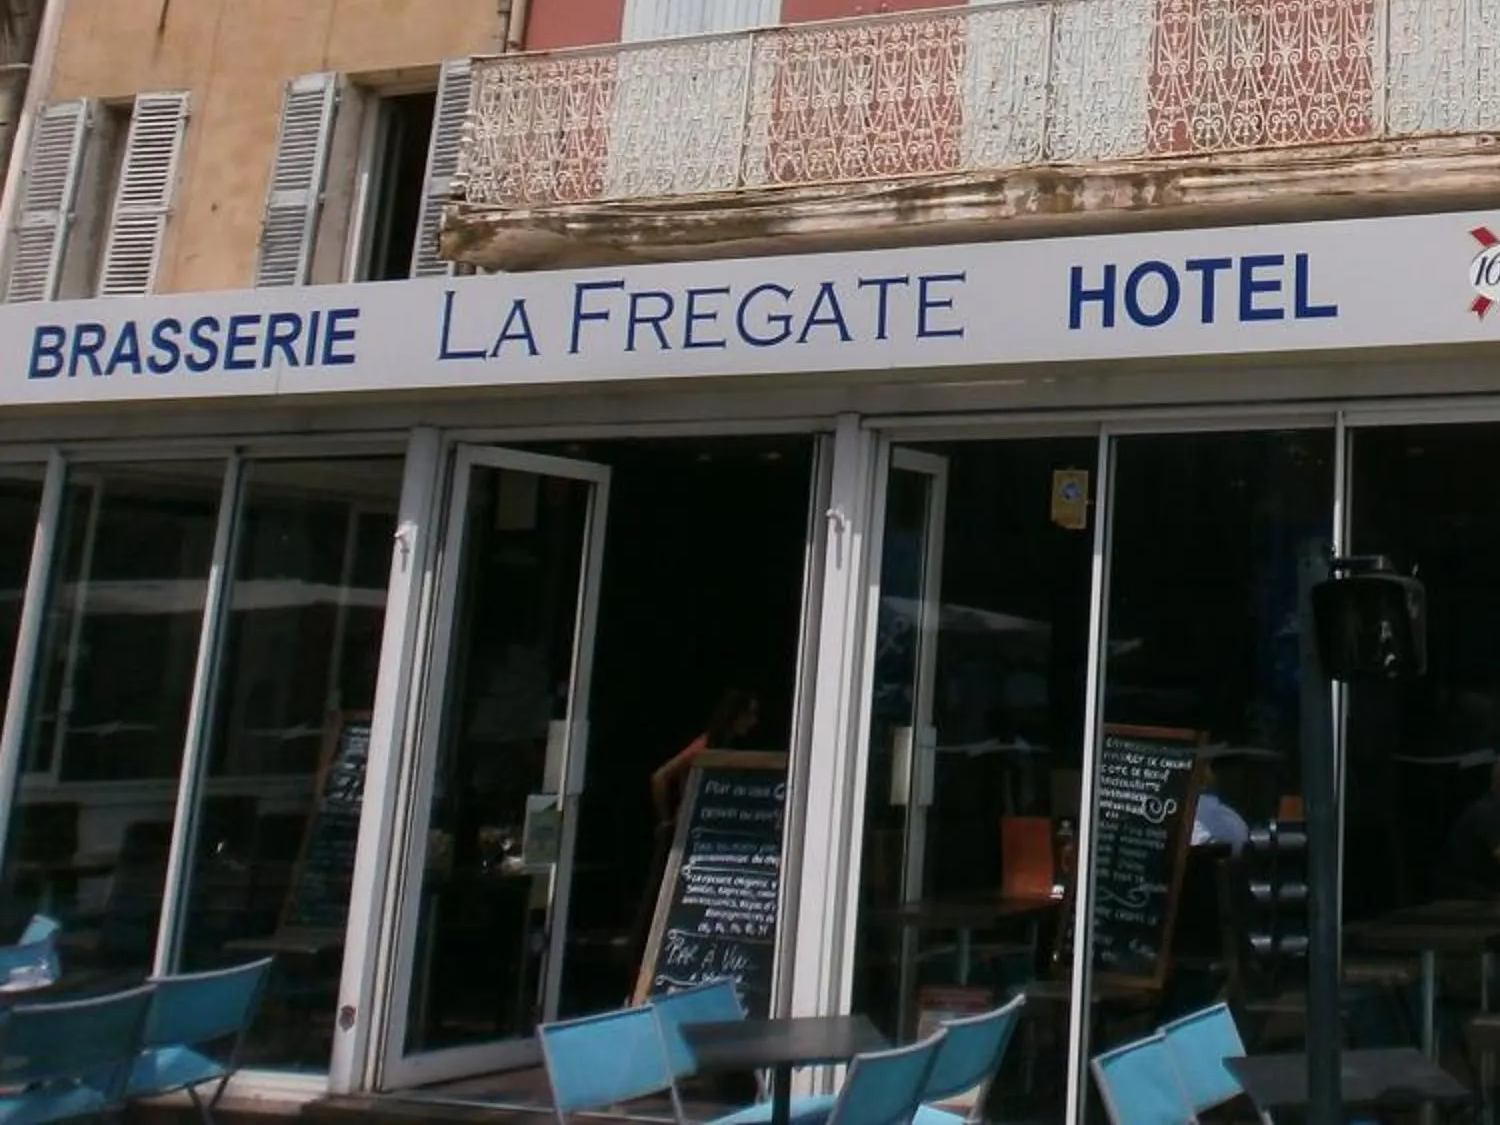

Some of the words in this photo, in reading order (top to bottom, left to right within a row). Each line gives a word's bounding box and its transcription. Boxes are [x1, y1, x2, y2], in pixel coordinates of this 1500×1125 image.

[27, 308, 361, 380] BRASSERIE
[438, 290, 541, 361] LA
[567, 271, 967, 355] FREGATE
[1068, 252, 1339, 331] HOTEL
